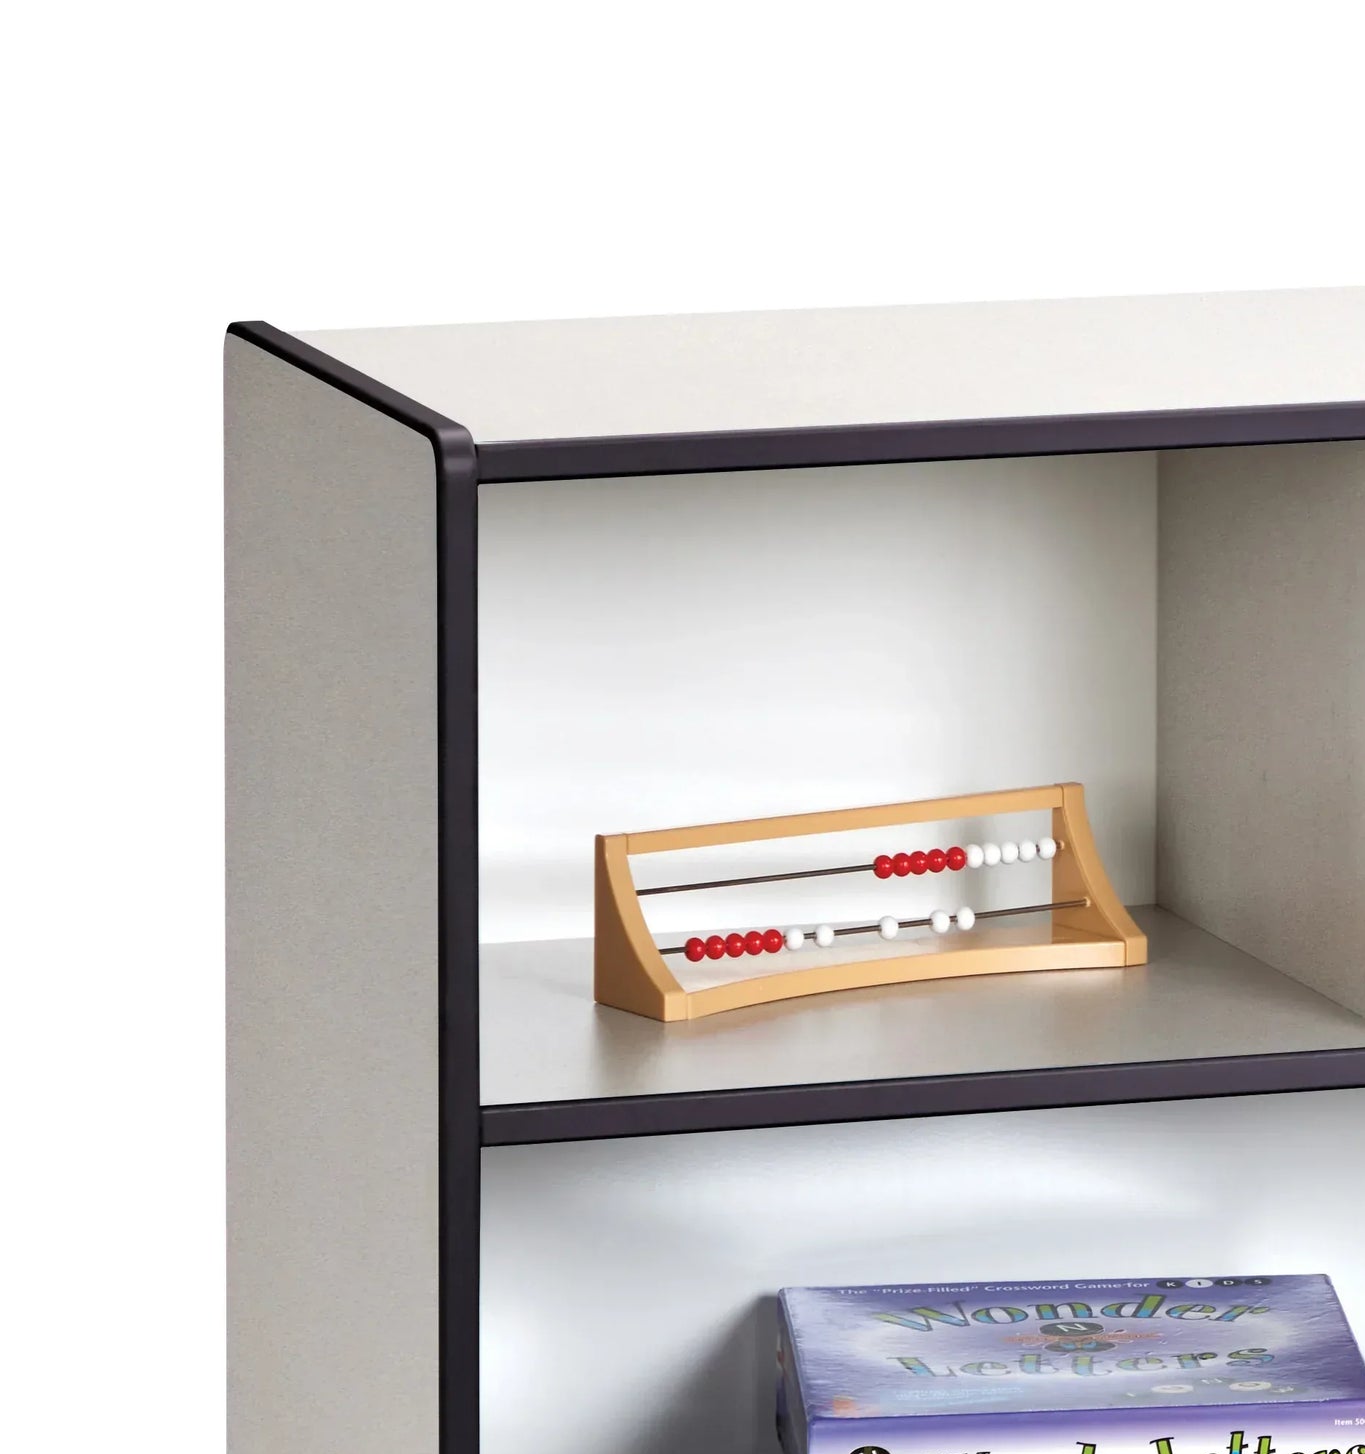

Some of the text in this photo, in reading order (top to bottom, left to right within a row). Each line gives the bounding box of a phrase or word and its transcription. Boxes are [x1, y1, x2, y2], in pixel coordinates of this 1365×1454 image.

[984, 1282, 1070, 1292] Crossword
[1074, 1281, 1122, 1290] Game
[1123, 1281, 1151, 1289] for
[871, 1293, 1272, 1333] Wonder
[887, 1348, 1275, 1378] Letters
[1335, 1418, 1353, 1426] Item
